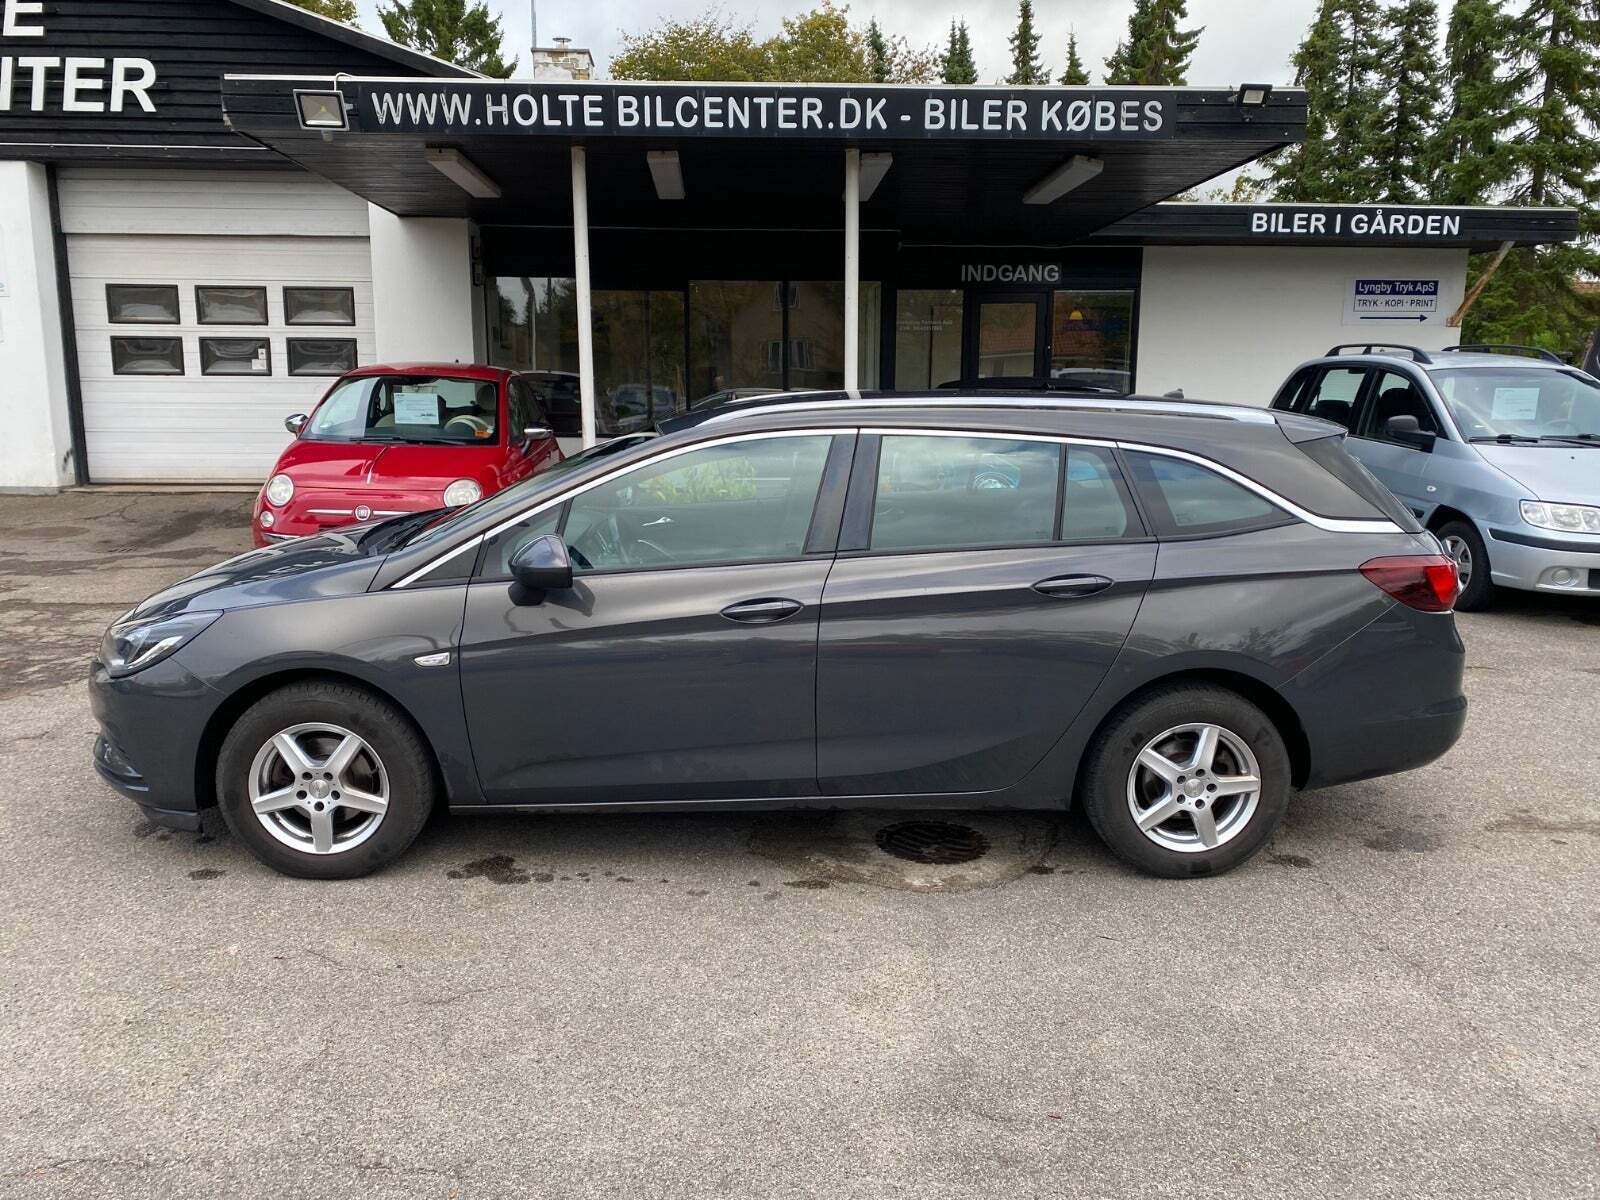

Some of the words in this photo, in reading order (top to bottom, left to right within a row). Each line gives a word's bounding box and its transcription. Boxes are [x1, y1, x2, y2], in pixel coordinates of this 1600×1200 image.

[0, 56, 157, 113] TER
[371, 92, 604, 127] WWW.HOLTE
[617, 95, 888, 131] BILCENTER.DK
[924, 98, 1028, 131] BILER
[1041, 99, 1163, 132] KØBES
[1251, 212, 1327, 234] BILER
[1335, 213, 1342, 234] I
[1350, 209, 1461, 236] GÅRDEN
[961, 264, 1060, 283] INDGANG
[1359, 282, 1392, 294] Lyngby
[1394, 282, 1414, 294] Tryk
[1415, 282, 1435, 294] ApS
[1358, 299, 1379, 307] TRYK
[1385, 299, 1404, 307] KOPI
